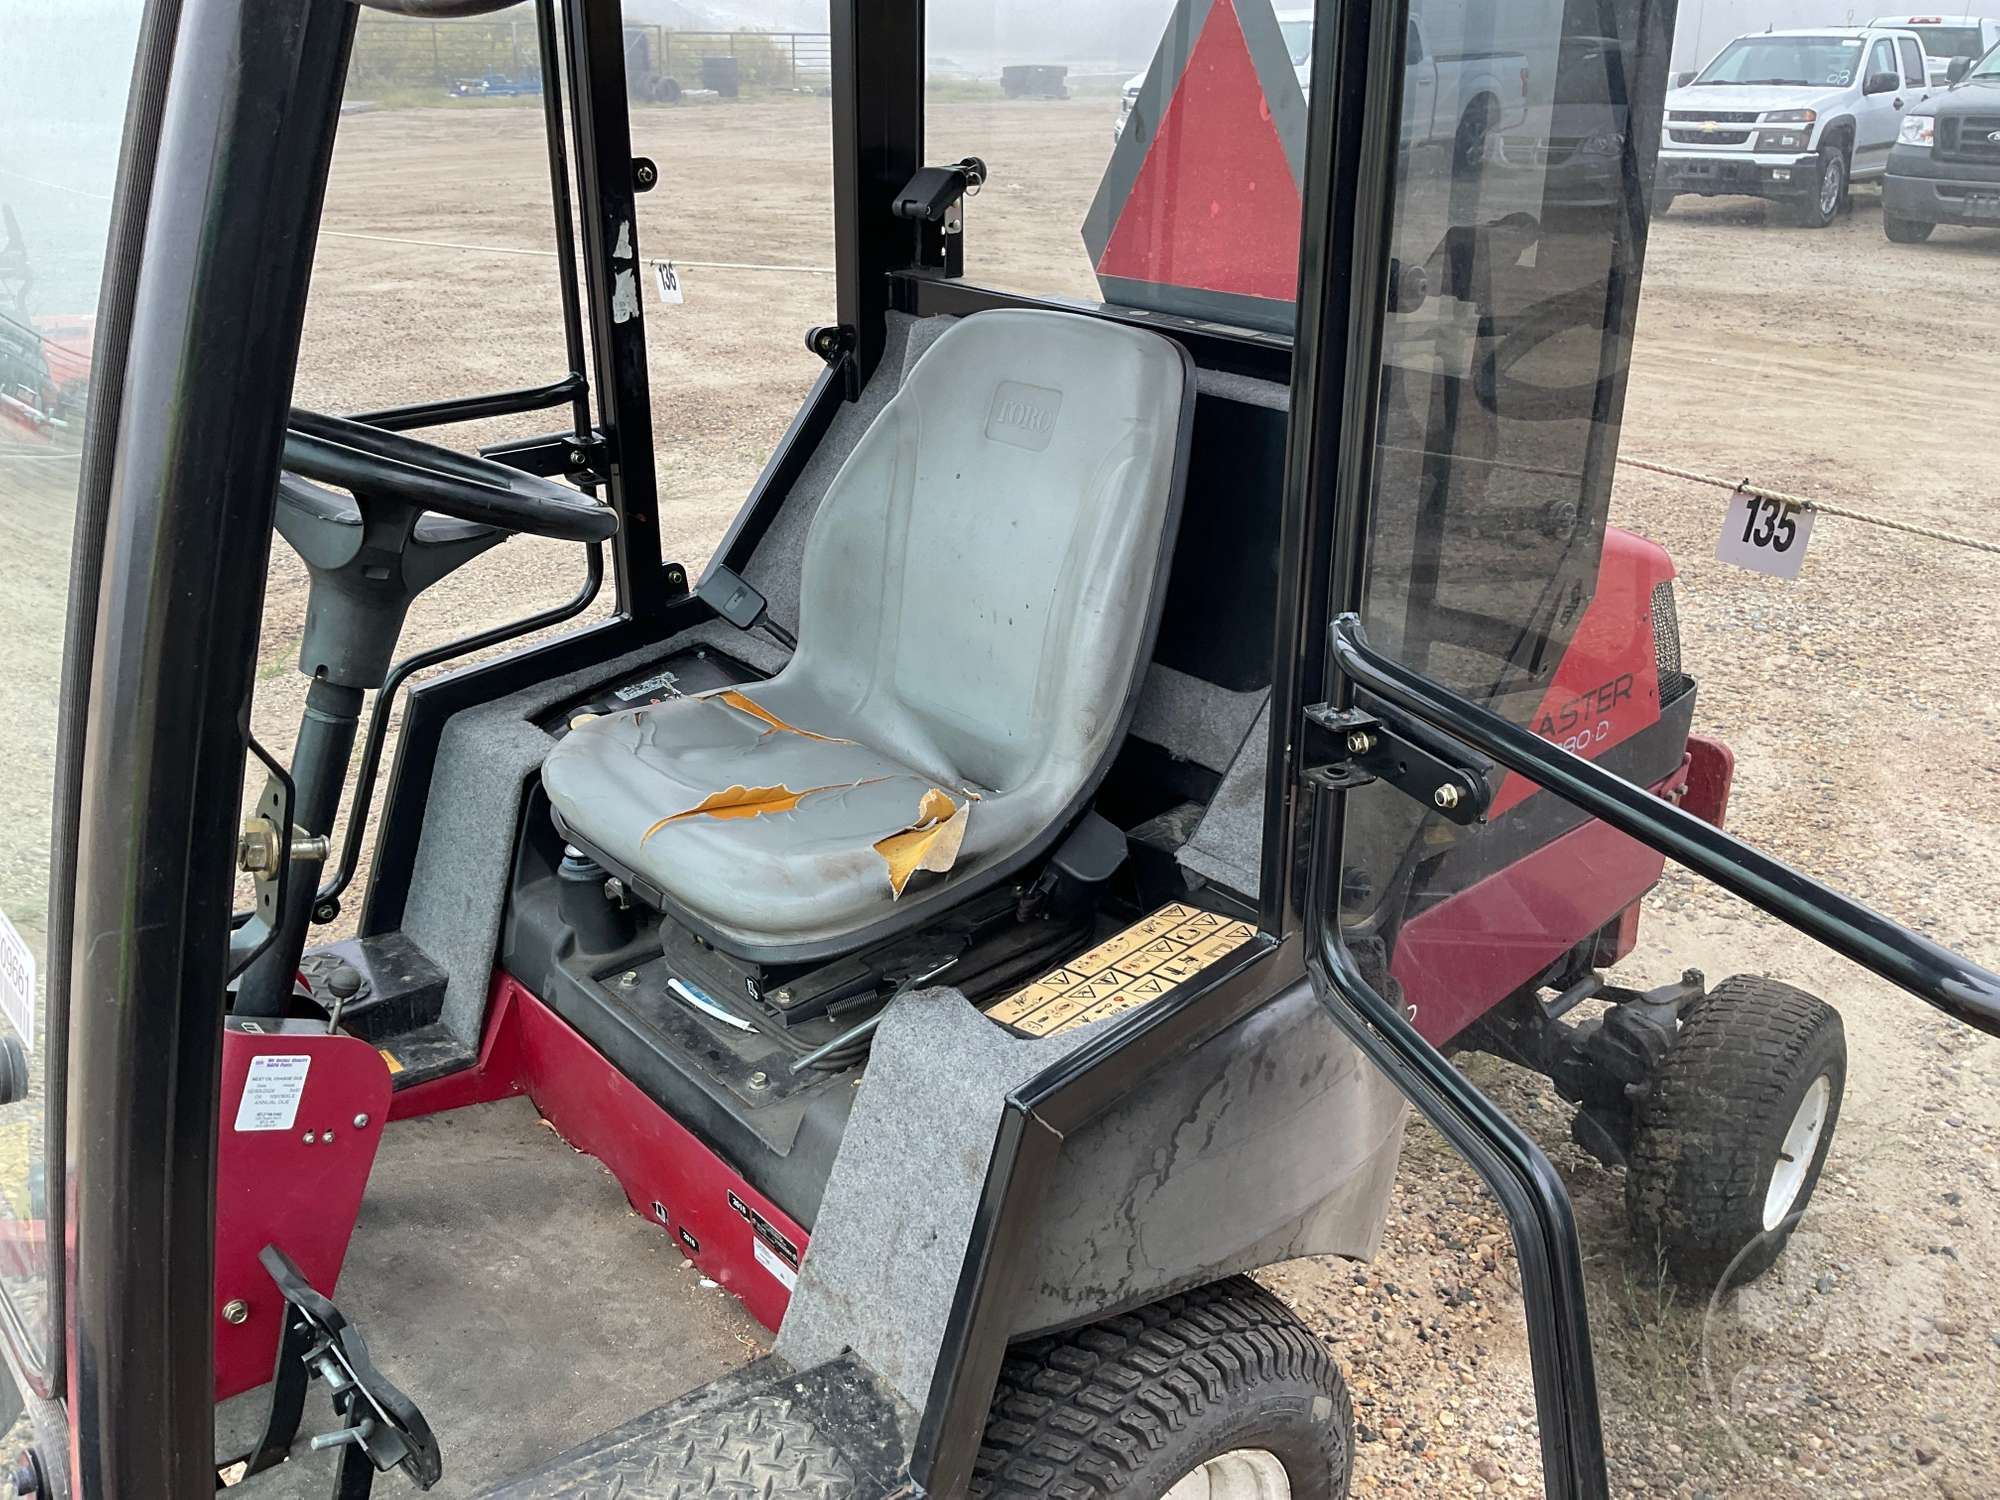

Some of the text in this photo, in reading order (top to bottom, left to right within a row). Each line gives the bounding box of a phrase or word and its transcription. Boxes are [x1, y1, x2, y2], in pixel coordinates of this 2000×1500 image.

[659, 263, 677, 291] 136
[996, 399, 1056, 433] TORO
[1742, 495, 1801, 552] 135
